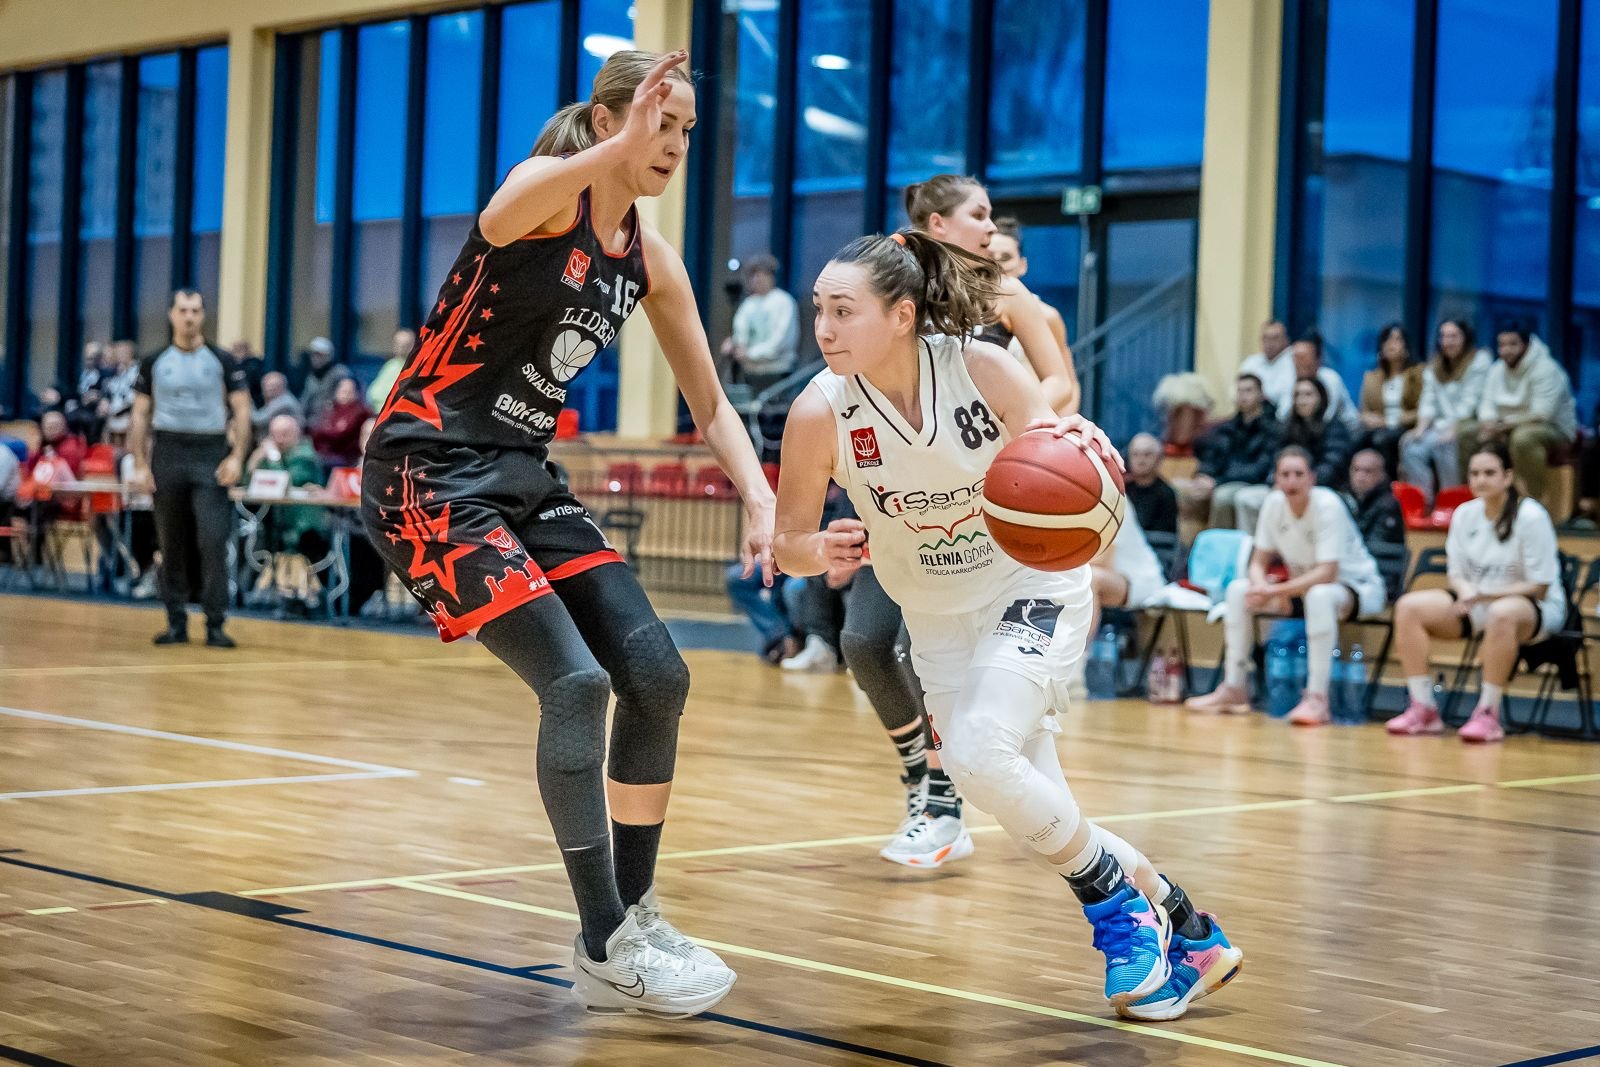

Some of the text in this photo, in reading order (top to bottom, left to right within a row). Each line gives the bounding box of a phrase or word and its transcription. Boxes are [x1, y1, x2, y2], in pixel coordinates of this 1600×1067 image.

[611, 274, 639, 319] 16
[559, 307, 615, 348] LIDER
[495, 393, 556, 430] BIOFAR
[954, 399, 1000, 450] 83
[920, 552, 963, 566] JELENIA
[964, 541, 995, 564] GÓRA
[926, 559, 994, 576] STOLICA KARKONOSZY
